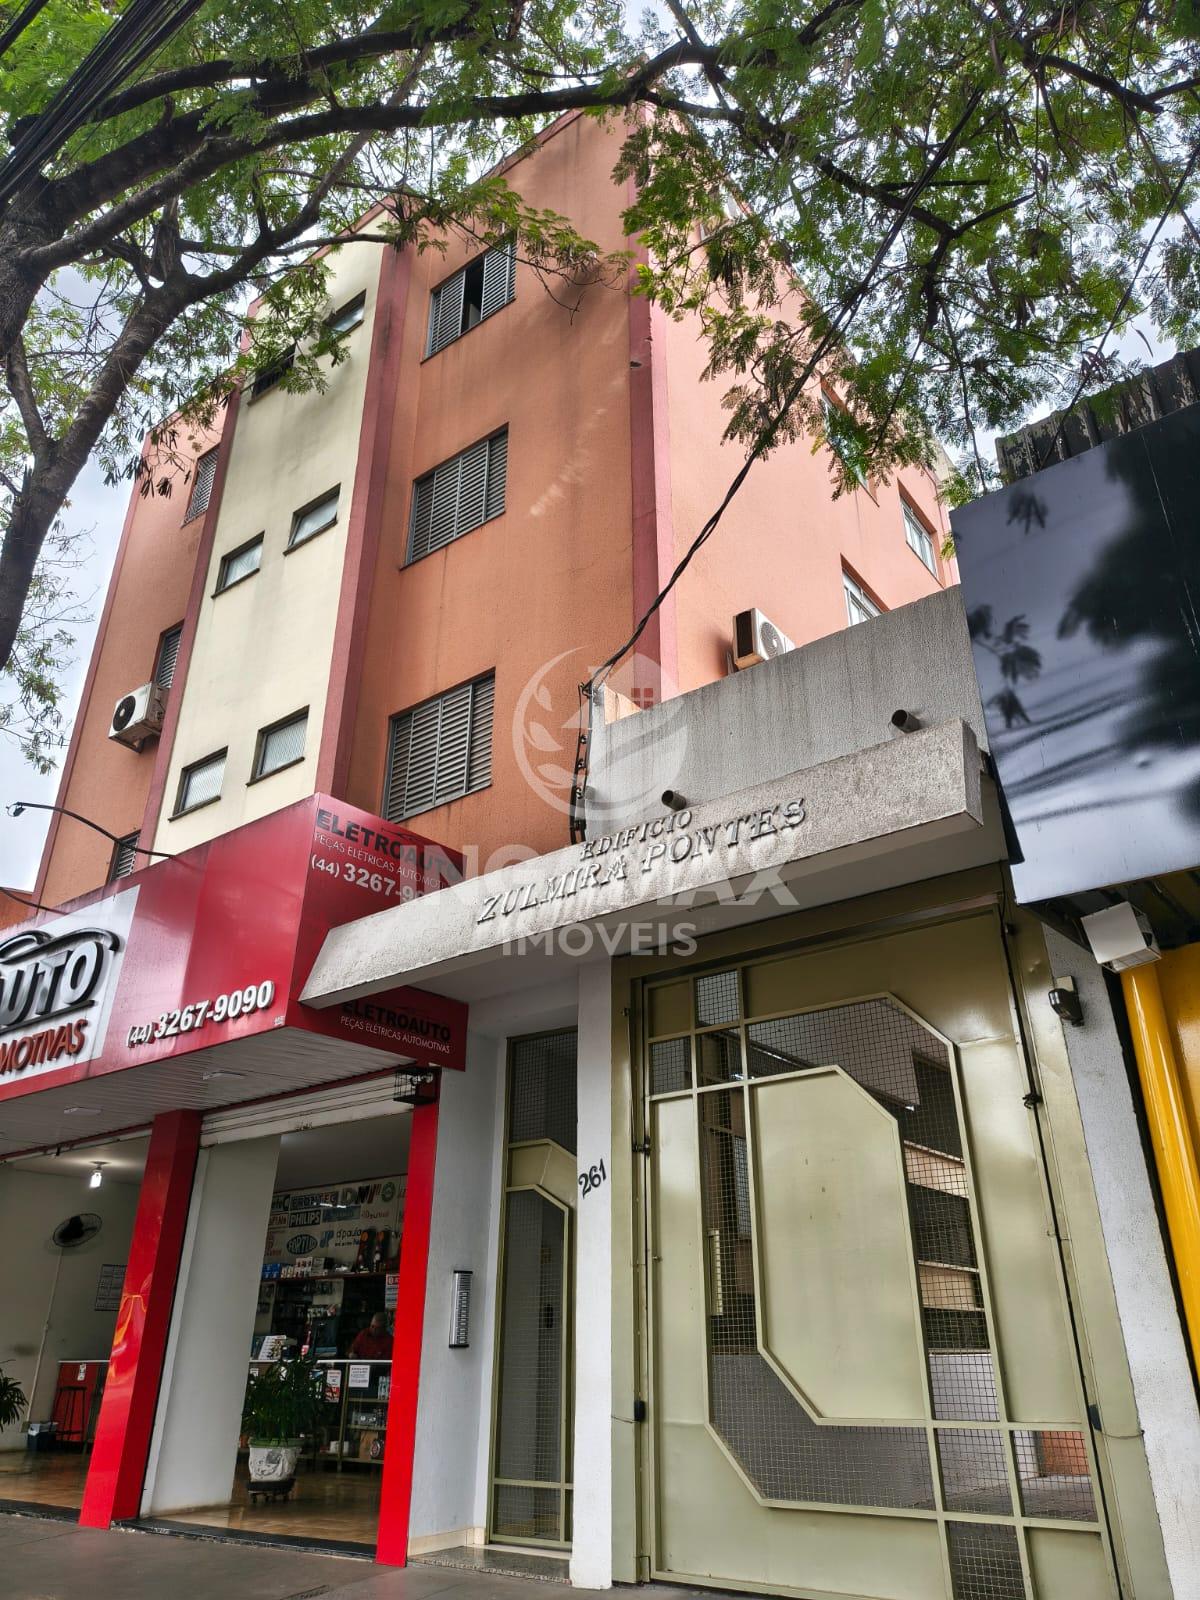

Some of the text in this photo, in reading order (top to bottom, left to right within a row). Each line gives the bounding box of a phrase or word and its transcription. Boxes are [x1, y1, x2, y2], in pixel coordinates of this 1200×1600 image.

[314, 831, 345, 854] PEÇAS
[316, 808, 459, 880] ELETROAUTO
[579, 810, 693, 861] EDIFICIO
[311, 854, 340, 879] (44)
[475, 855, 627, 924] ZULMIRA
[0, 941, 104, 1027] UTO
[126, 980, 275, 1048] (44) 3267-9090
[340, 1015, 364, 1031] PEÇAS
[342, 1000, 451, 1042] ELETROAUTO
[578, 1158, 608, 1199] 261
[290, 1210, 321, 1226] PHILIPS
